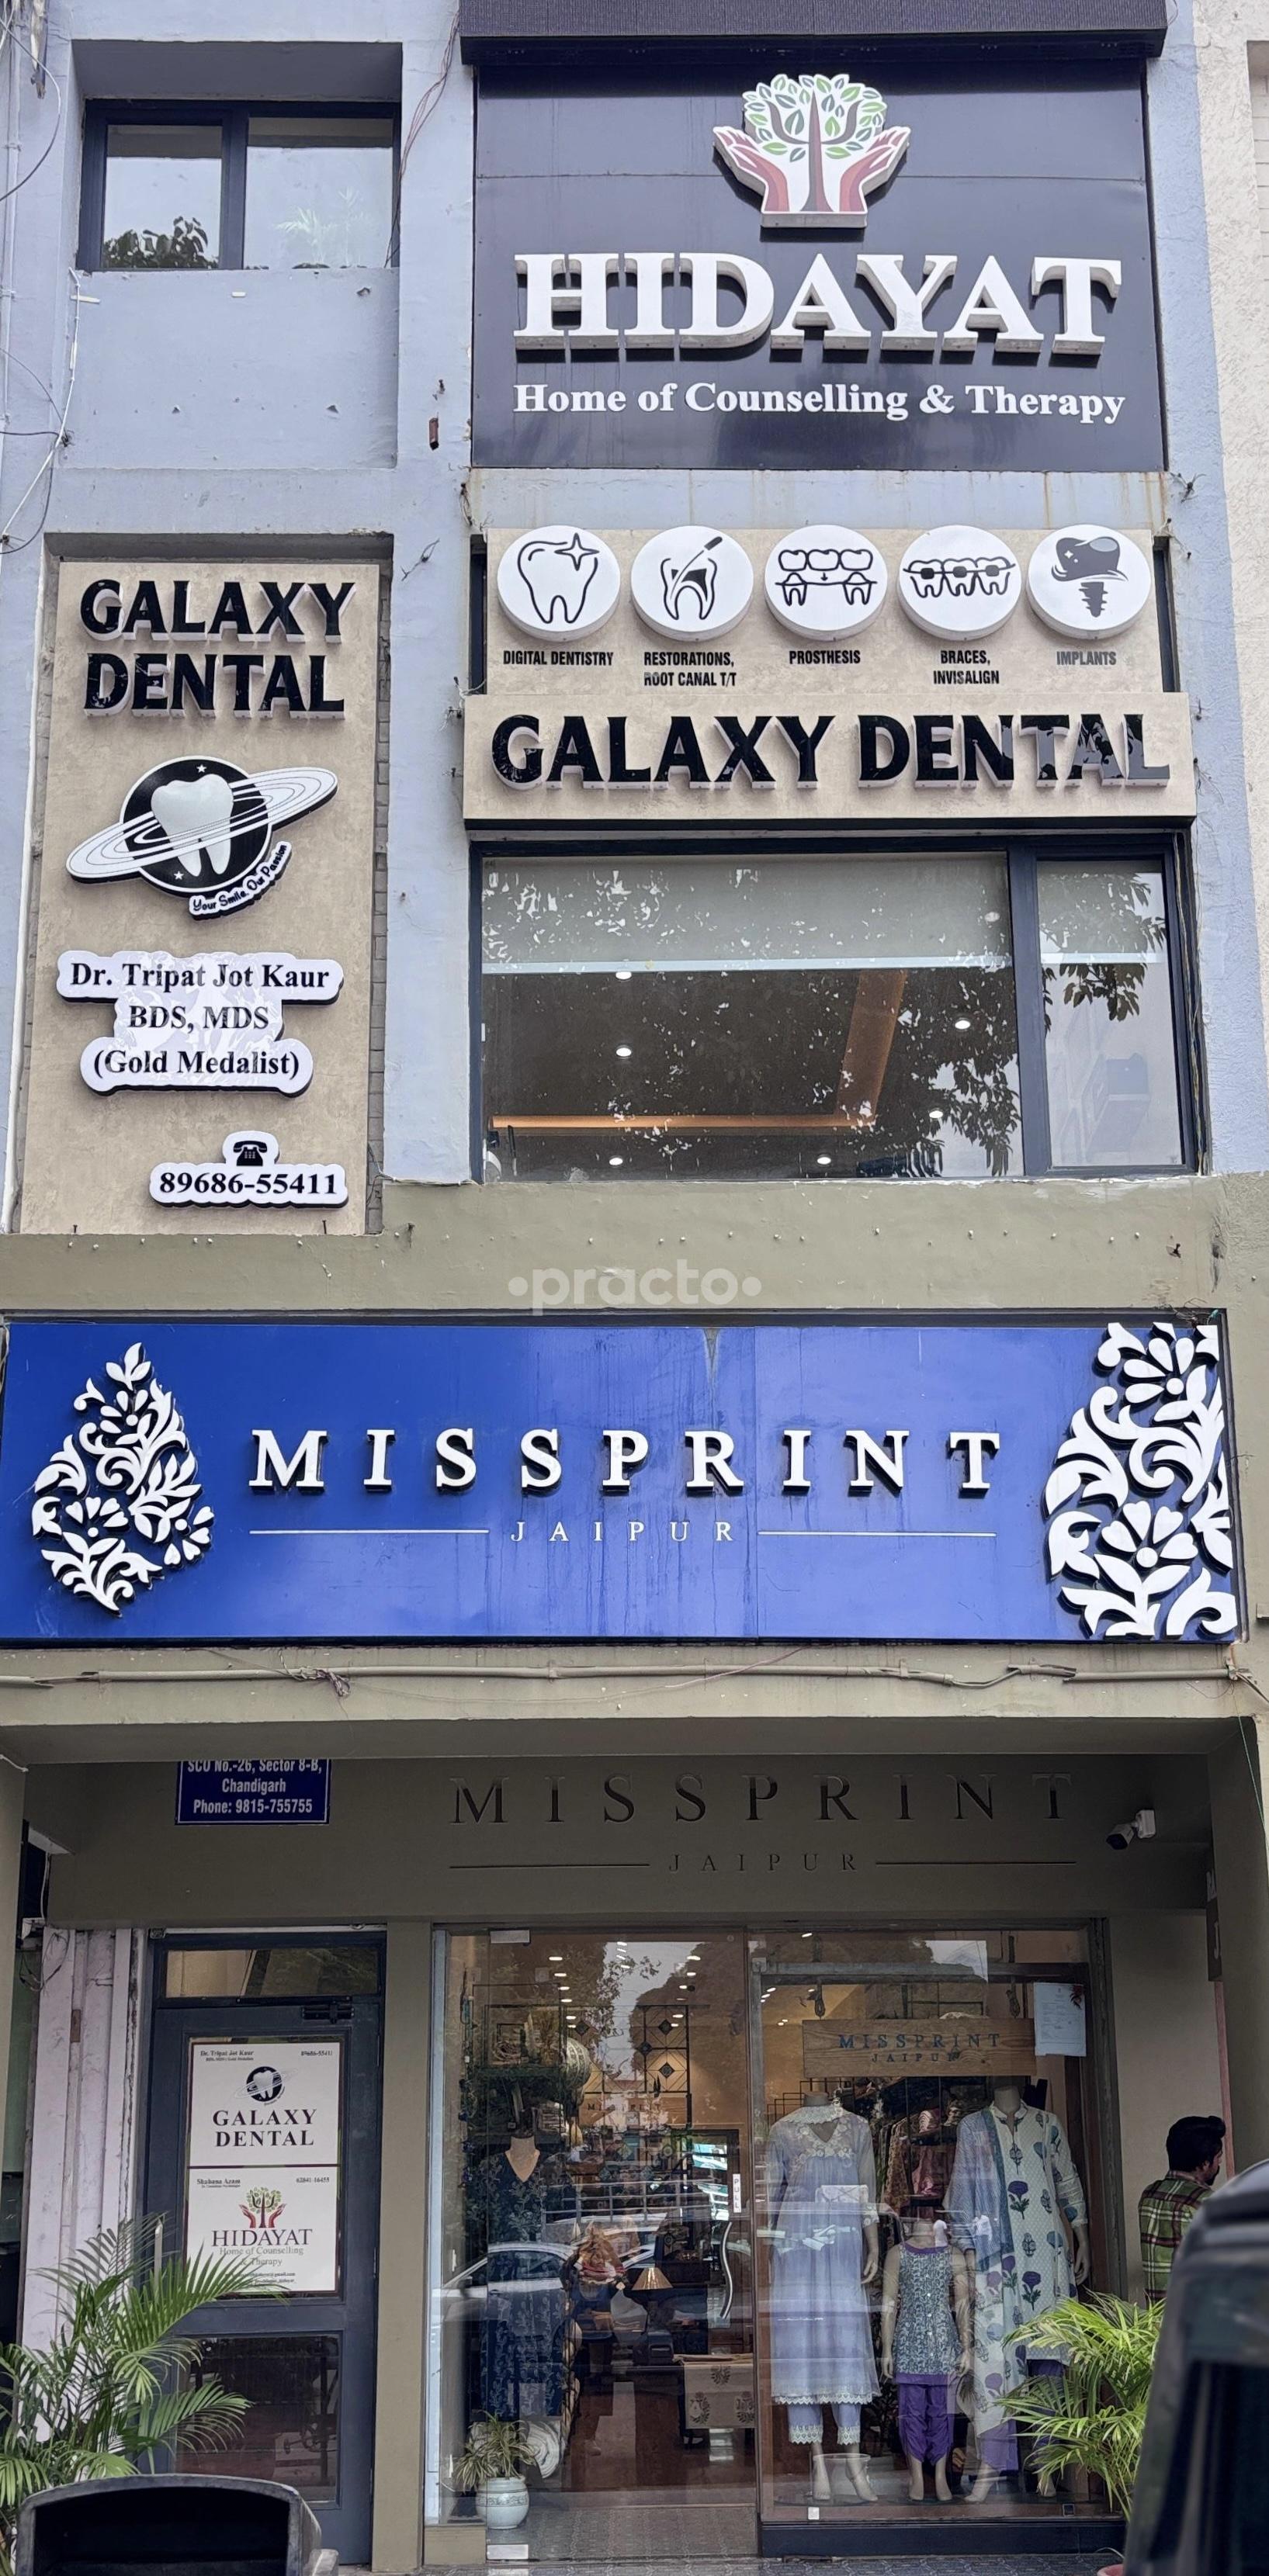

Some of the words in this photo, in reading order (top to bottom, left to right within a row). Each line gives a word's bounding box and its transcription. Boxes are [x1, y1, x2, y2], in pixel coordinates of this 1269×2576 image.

[514, 252, 1122, 355] HIDAYAT
[513, 383, 626, 414] Home
[637, 383, 680, 413] of
[685, 383, 908, 422] Counselling
[919, 385, 955, 414] &
[964, 385, 1126, 425] Therapy
[79, 579, 356, 642] GALAXY
[503, 651, 547, 665] DIGITAL
[551, 651, 614, 666] DENTISTRY
[643, 652, 734, 667] RESTORATIONS,
[789, 650, 861, 664] PROSTHESIS
[941, 650, 990, 666] BRACES,
[1056, 651, 1117, 666] IMPLANTS
[84, 653, 345, 718] DENTAL
[643, 672, 674, 687] ROOT
[678, 672, 717, 687] CANAL
[720, 672, 737, 687] T/T
[933, 670, 1000, 685] INVISALIGN
[491, 715, 835, 790] GALAXY
[857, 714, 1171, 788] DENTAL
[193, 898, 217, 911] Your
[247, 877, 265, 891] Our
[261, 845, 287, 878] Passion
[71, 963, 113, 985] Dr.
[123, 963, 206, 993] Tripat
[213, 964, 253, 988] Jot
[262, 964, 329, 988] Kaur
[129, 1005, 194, 1033] BDS,
[203, 1006, 269, 1030] MDS
[94, 1050, 167, 1079] (Gold
[177, 1051, 300, 1080] Medalist)
[160, 1172, 337, 1194] 89686-55411
[248, 1428, 1000, 1494] MISSPRINT
[511, 1521, 734, 1542] JAIPUR
[187, 1760, 210, 1772] SCO
[259, 1759, 295, 1772] Sector
[222, 1778, 286, 1795] Chandigarh
[193, 1799, 232, 1813] Phone:
[236, 1799, 312, 1813] 9815-755755
[449, 1773, 1076, 1824] MISSPRINT
[668, 1854, 858, 1872] JAIPUR
[838, 2033, 1000, 2049] MISSPRINT
[872, 2052, 957, 2062] JAIPUR
[213, 2109, 317, 2127] GALAXY
[215, 2130, 314, 2148] DENTAL
[211, 2228, 313, 2247] HIDAYAT
[220, 2247, 244, 2256] Home
[256, 2246, 303, 2256] Counselling
[250, 2257, 283, 2267] Therapy
